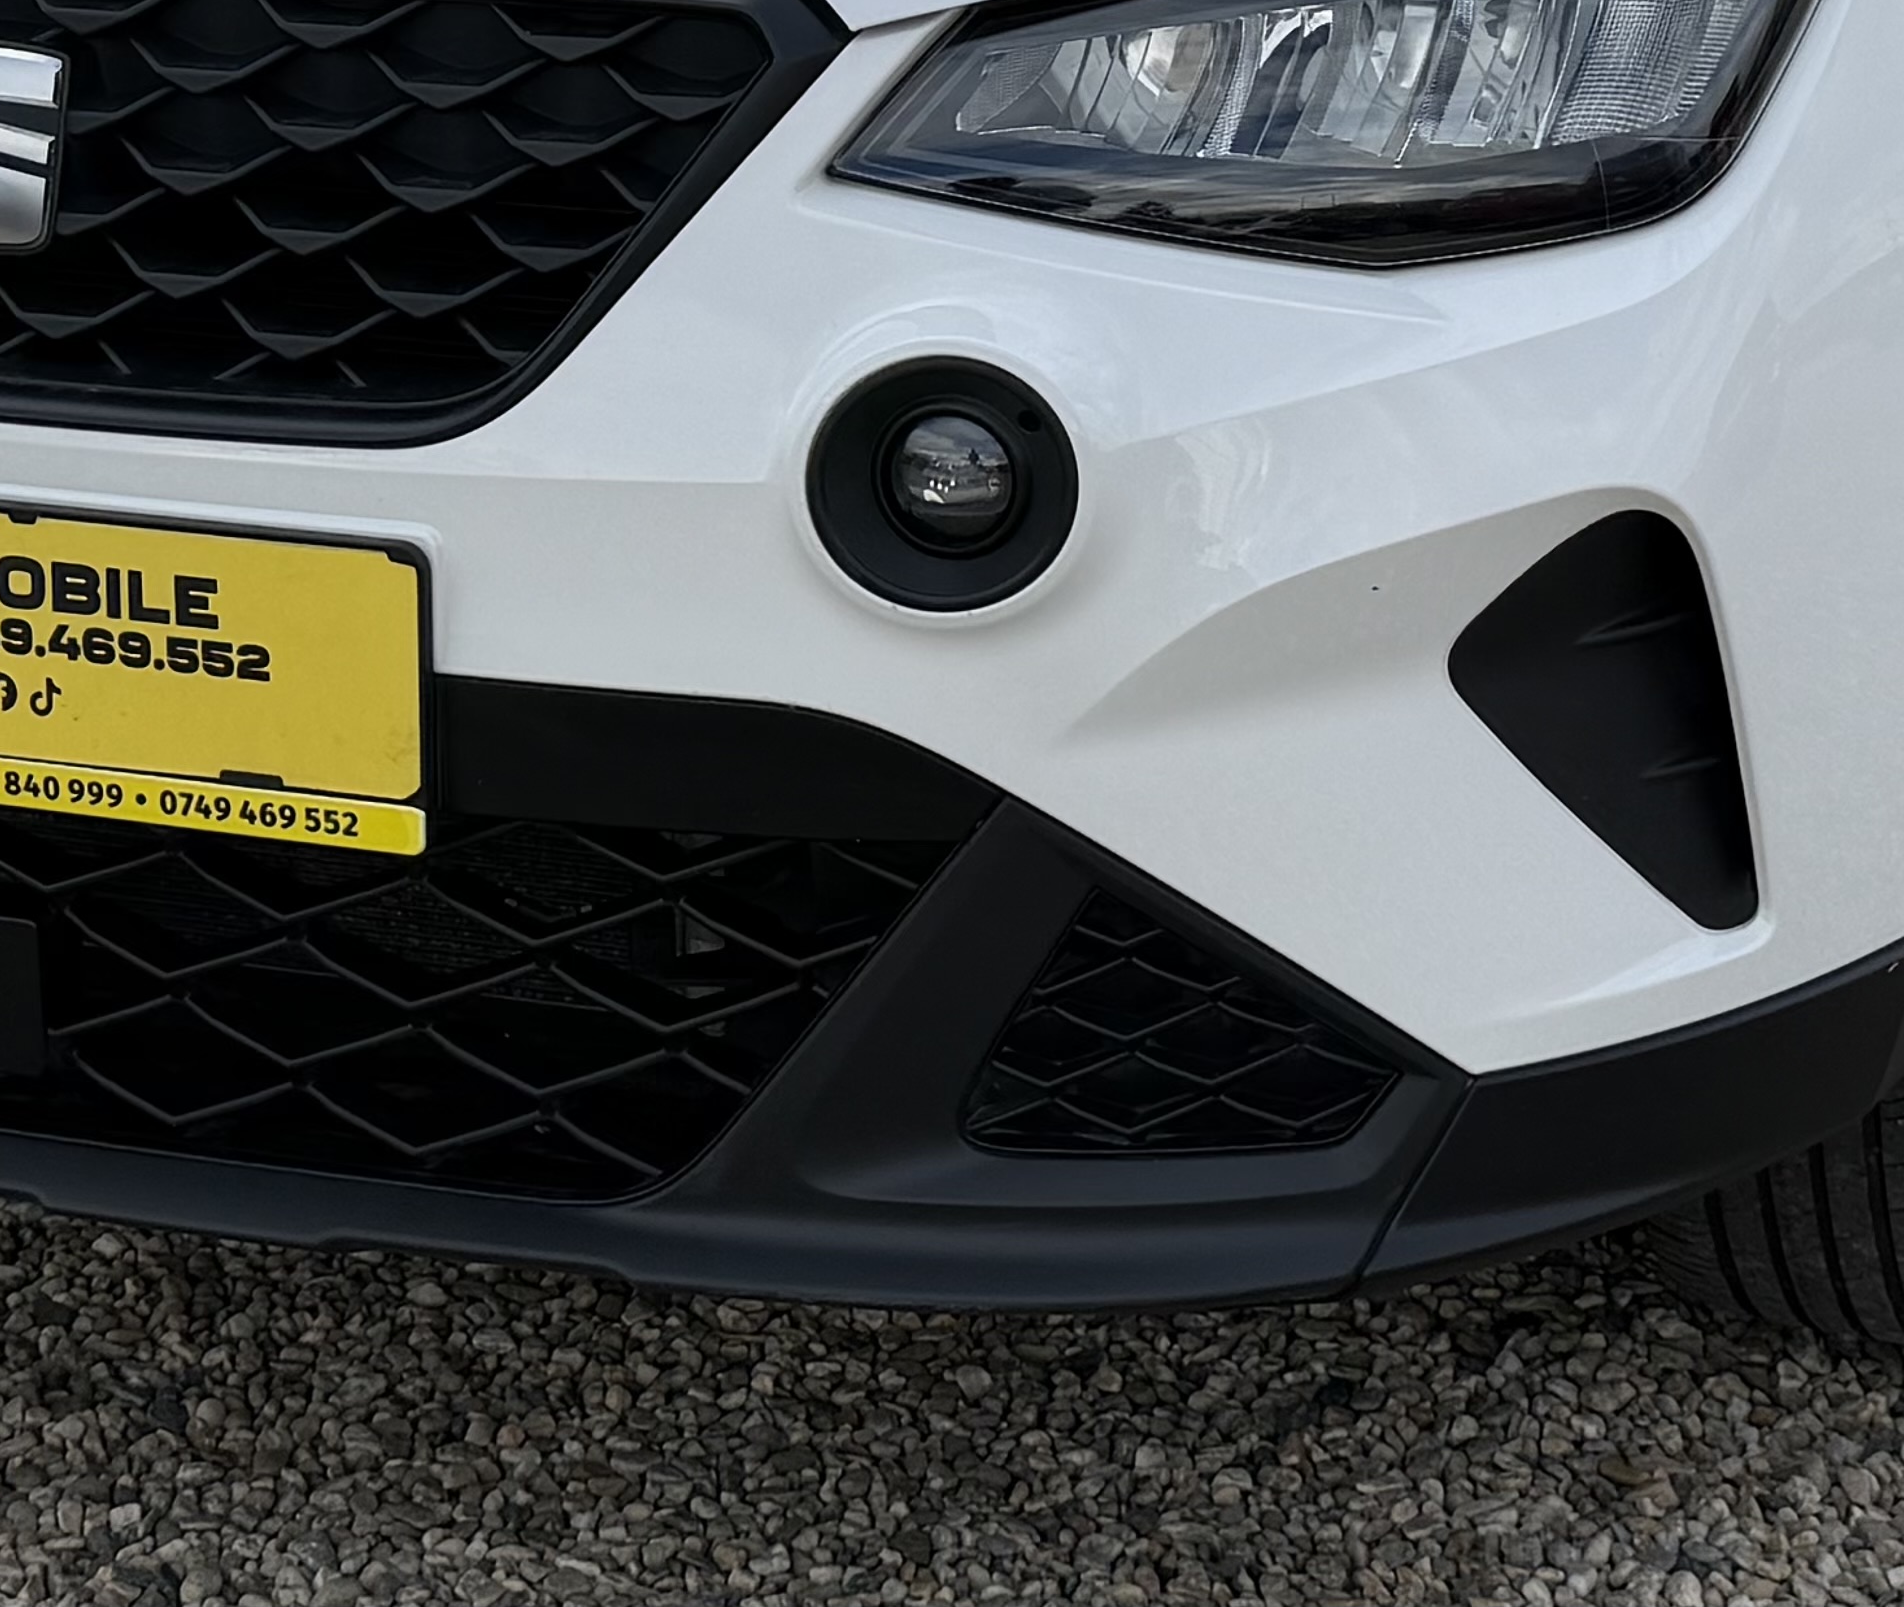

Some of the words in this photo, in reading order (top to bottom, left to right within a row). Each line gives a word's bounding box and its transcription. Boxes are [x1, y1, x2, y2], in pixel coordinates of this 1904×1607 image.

[4, 772, 60, 801] 840
[68, 779, 124, 808] 999
[159, 790, 232, 822] 0749
[239, 799, 297, 830] 469
[304, 807, 360, 837] 552
